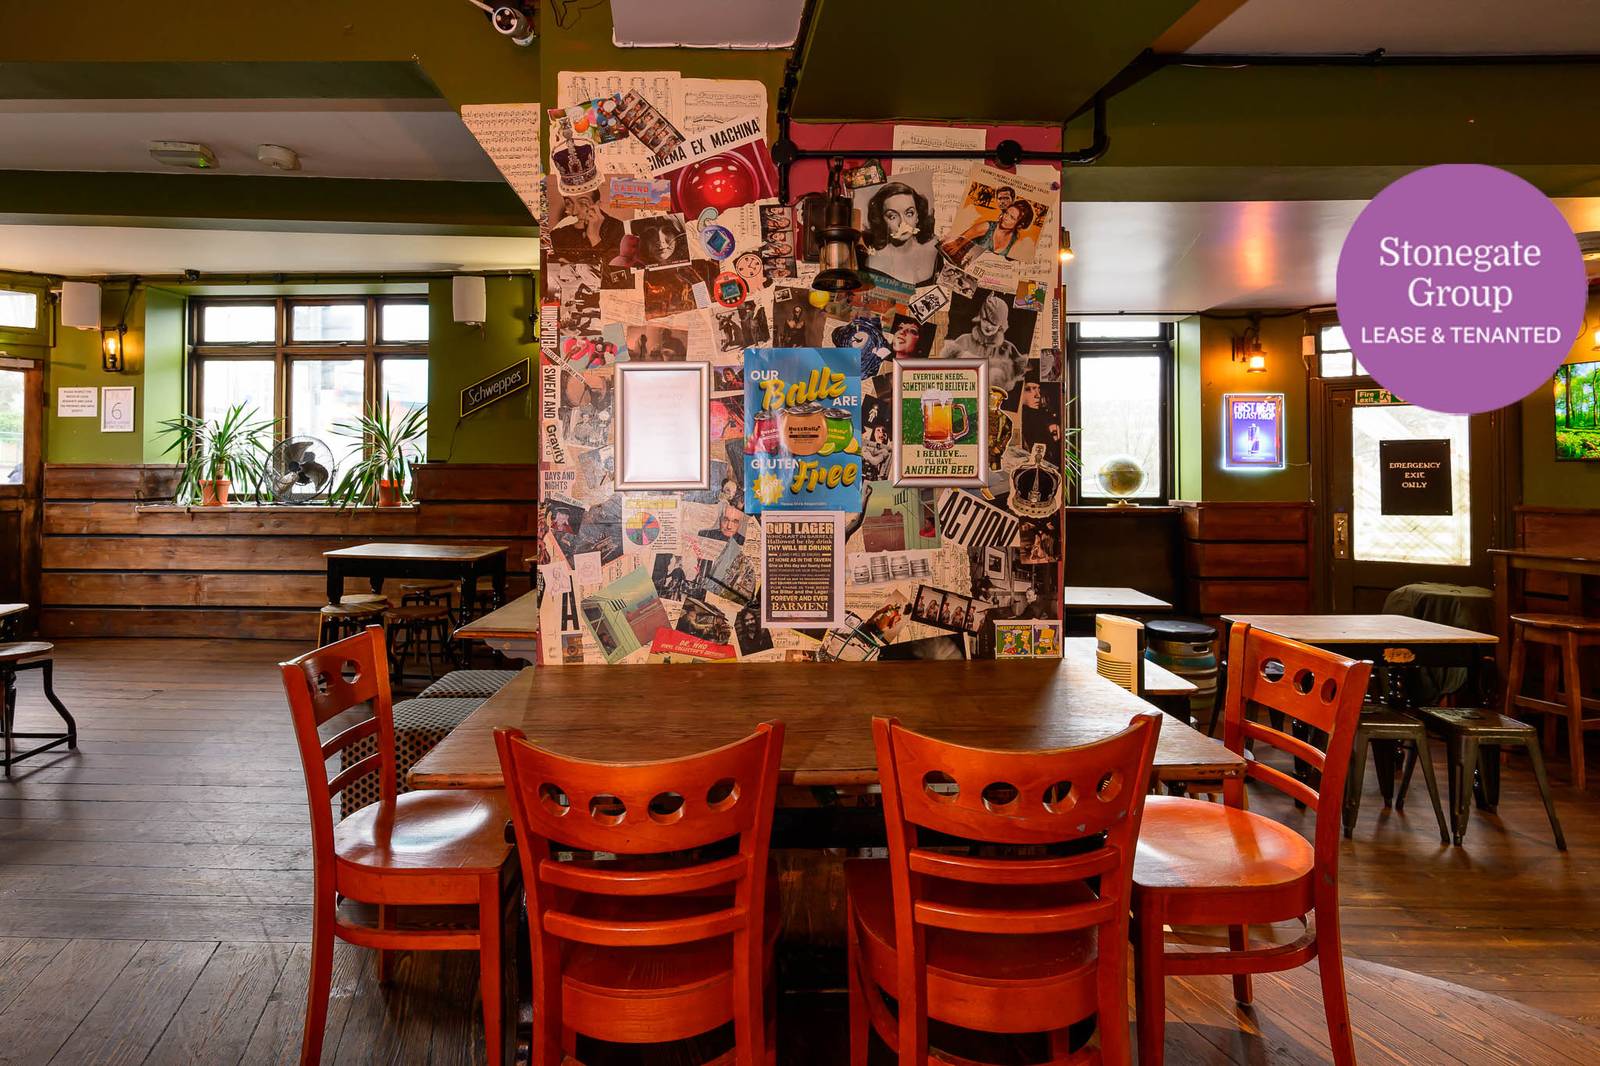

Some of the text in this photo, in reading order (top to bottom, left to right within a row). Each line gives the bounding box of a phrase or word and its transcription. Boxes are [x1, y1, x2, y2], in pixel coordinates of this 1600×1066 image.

[691, 138, 706, 155] EX
[710, 119, 760, 149] MACHINA
[750, 370, 780, 380] OUR
[468, 370, 522, 406] Schweppes
[759, 366, 848, 410] Ballz
[937, 382, 944, 391] TO
[945, 382, 968, 391] BELIEVE
[544, 368, 556, 419] SWEAT AND
[832, 396, 858, 406] ARE
[111, 402, 122, 420] 6
[1234, 403, 1255, 412] FIRST
[546, 425, 565, 464] Gravity
[751, 459, 802, 469] GLUTEN
[905, 466, 974, 474] ANOTHER BEER
[545, 472, 575, 480] DAYS AND
[790, 460, 857, 494] Free
[545, 481, 568, 490] NIGHTS
[766, 523, 833, 534] OUR LAGER
[772, 602, 828, 610] BARMEN!
